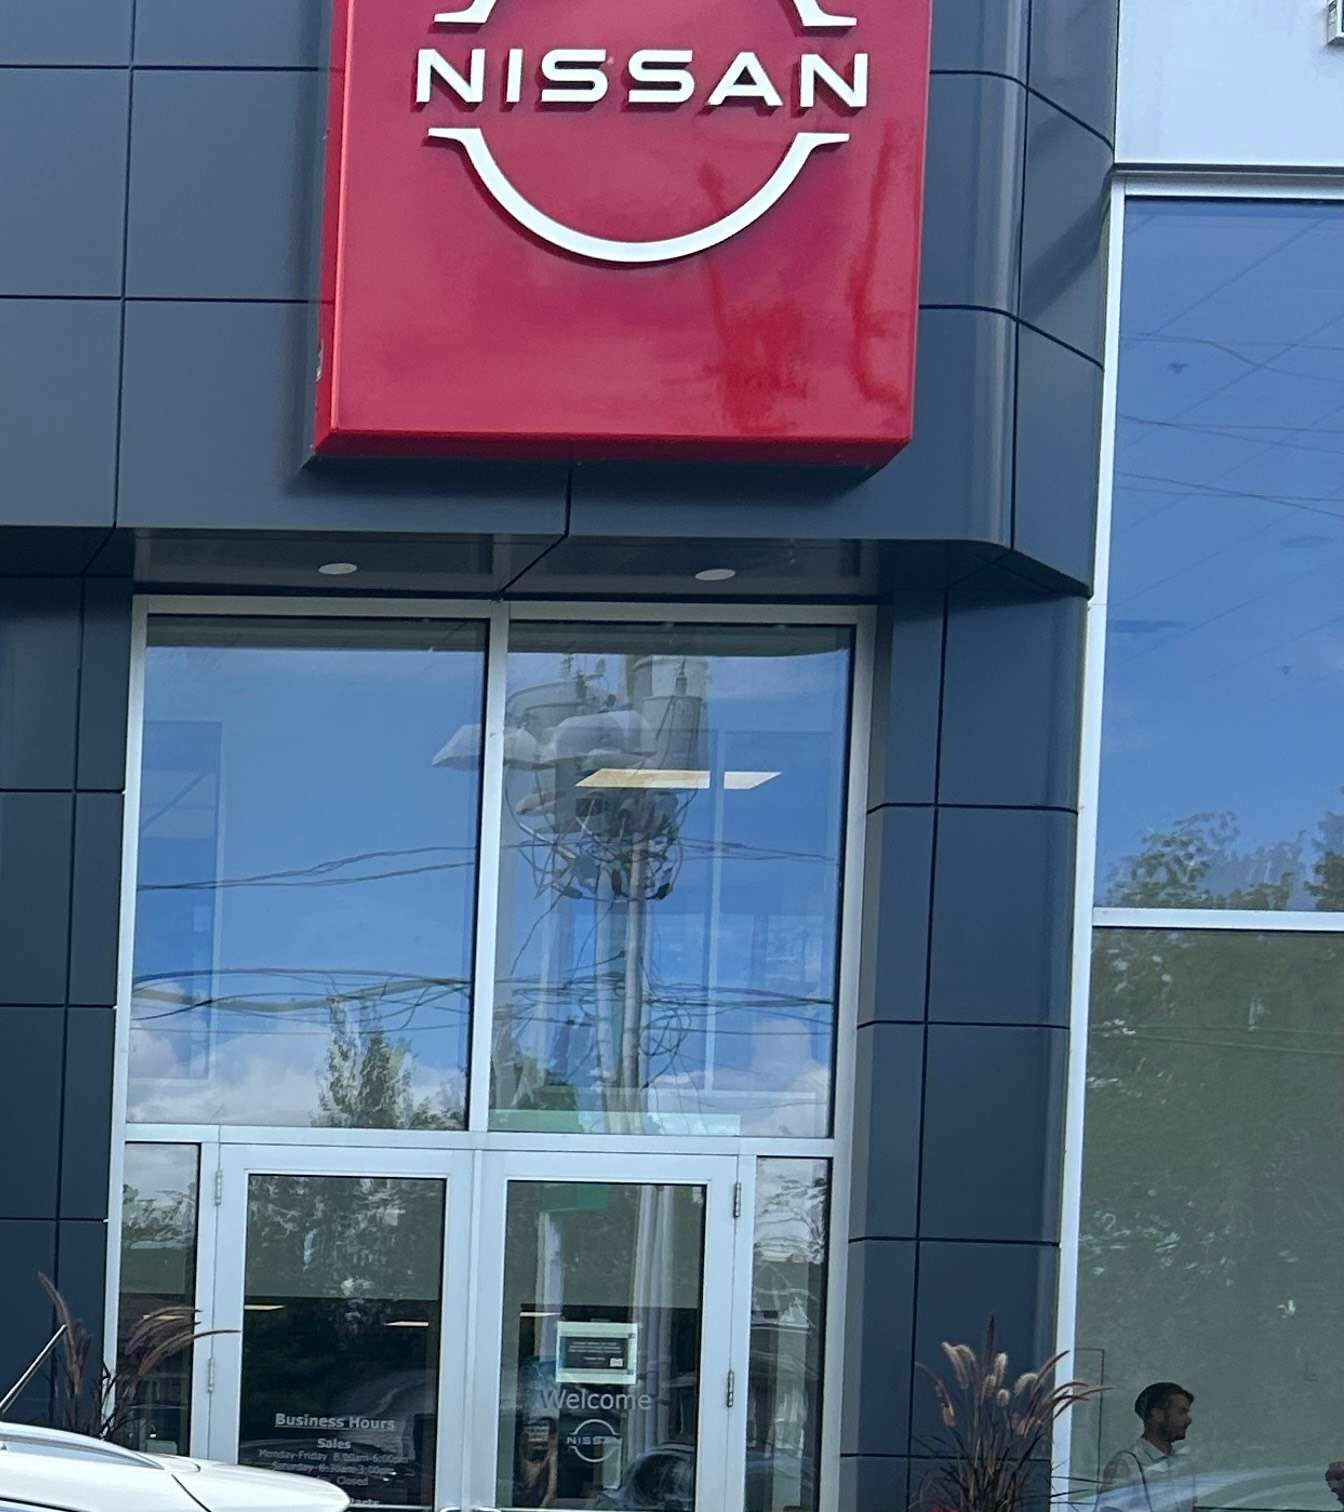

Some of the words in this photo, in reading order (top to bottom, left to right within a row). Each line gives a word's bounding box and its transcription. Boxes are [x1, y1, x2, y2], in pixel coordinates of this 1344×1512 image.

[416, 48, 868, 108] NISSAN
[540, 1388, 652, 1410] Welcome
[275, 1413, 345, 1428] Business
[349, 1416, 396, 1431] Hours
[317, 1438, 352, 1450] Sales
